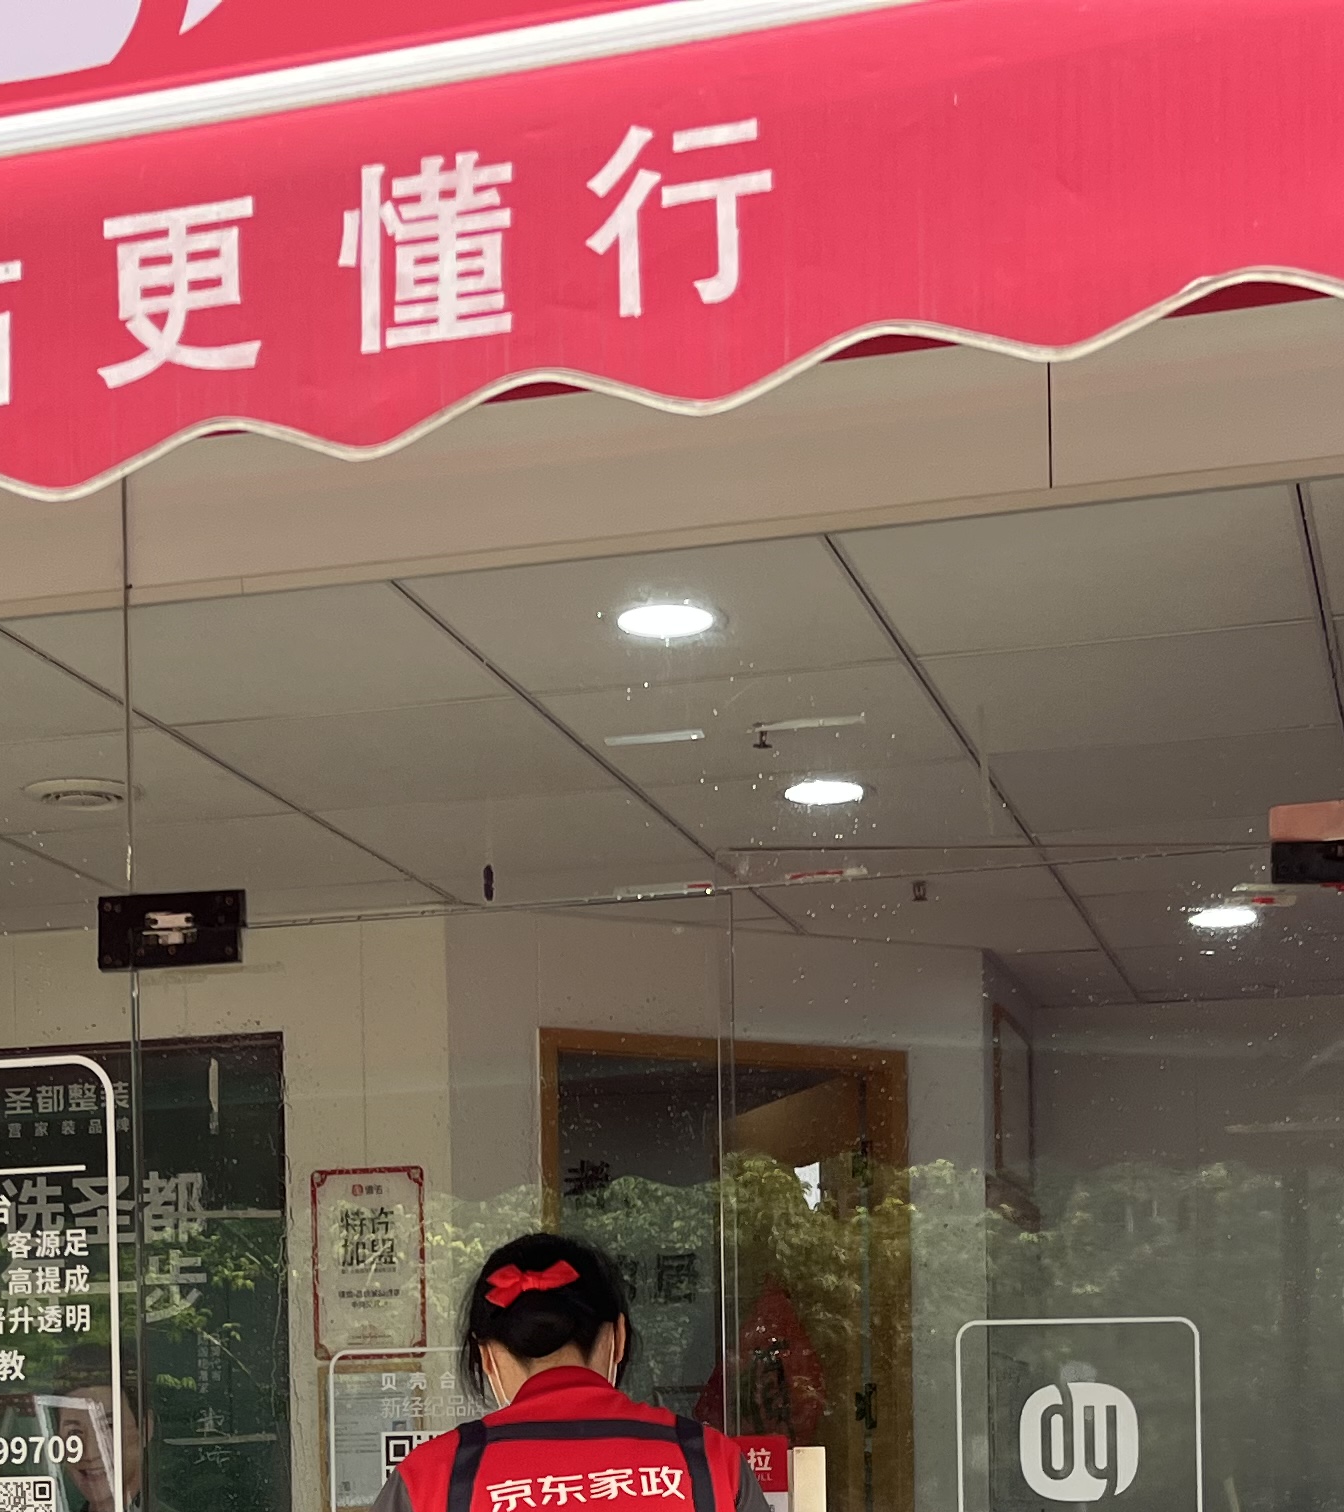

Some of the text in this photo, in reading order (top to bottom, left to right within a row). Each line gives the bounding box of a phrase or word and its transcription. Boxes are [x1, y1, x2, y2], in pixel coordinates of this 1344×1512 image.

[6, 1229, 91, 1259] 客源足
[7, 1264, 91, 1296] 高提成
[747, 1447, 773, 1472] 拉
